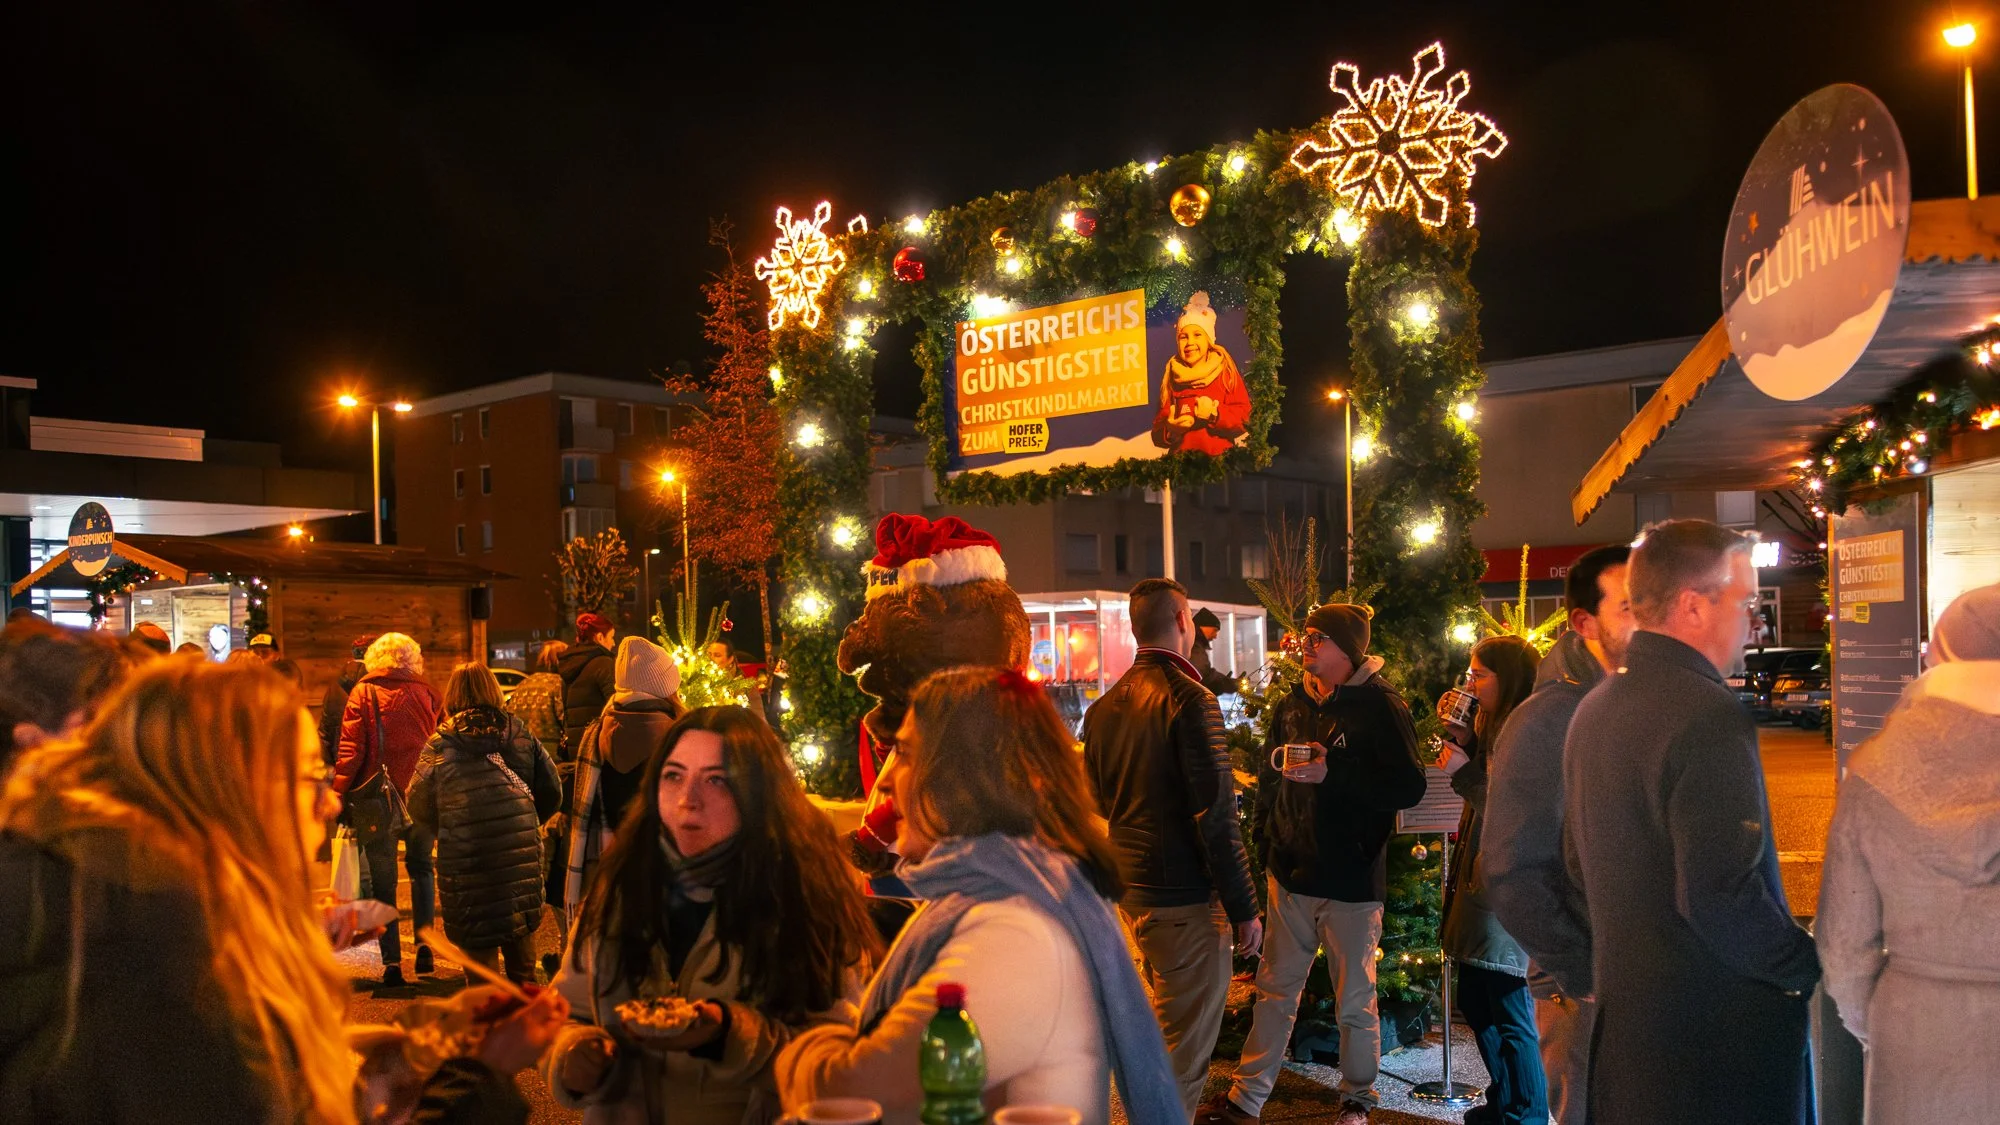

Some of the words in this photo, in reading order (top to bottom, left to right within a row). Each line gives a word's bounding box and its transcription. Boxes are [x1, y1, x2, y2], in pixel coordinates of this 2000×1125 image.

[1745, 170, 1895, 306] GLÜHWEIN
[961, 299, 1140, 357] ÖSTERREICHS
[962, 342, 1141, 396] GÜNSTIGSTER
[961, 381, 1145, 425] CHRISTKINDLMARKT
[961, 430, 999, 452] ZUM
[1009, 423, 1043, 436] HOFER
[1009, 436, 1043, 448] PREIS,-
[68, 531, 113, 547] KINDERPUNSCH
